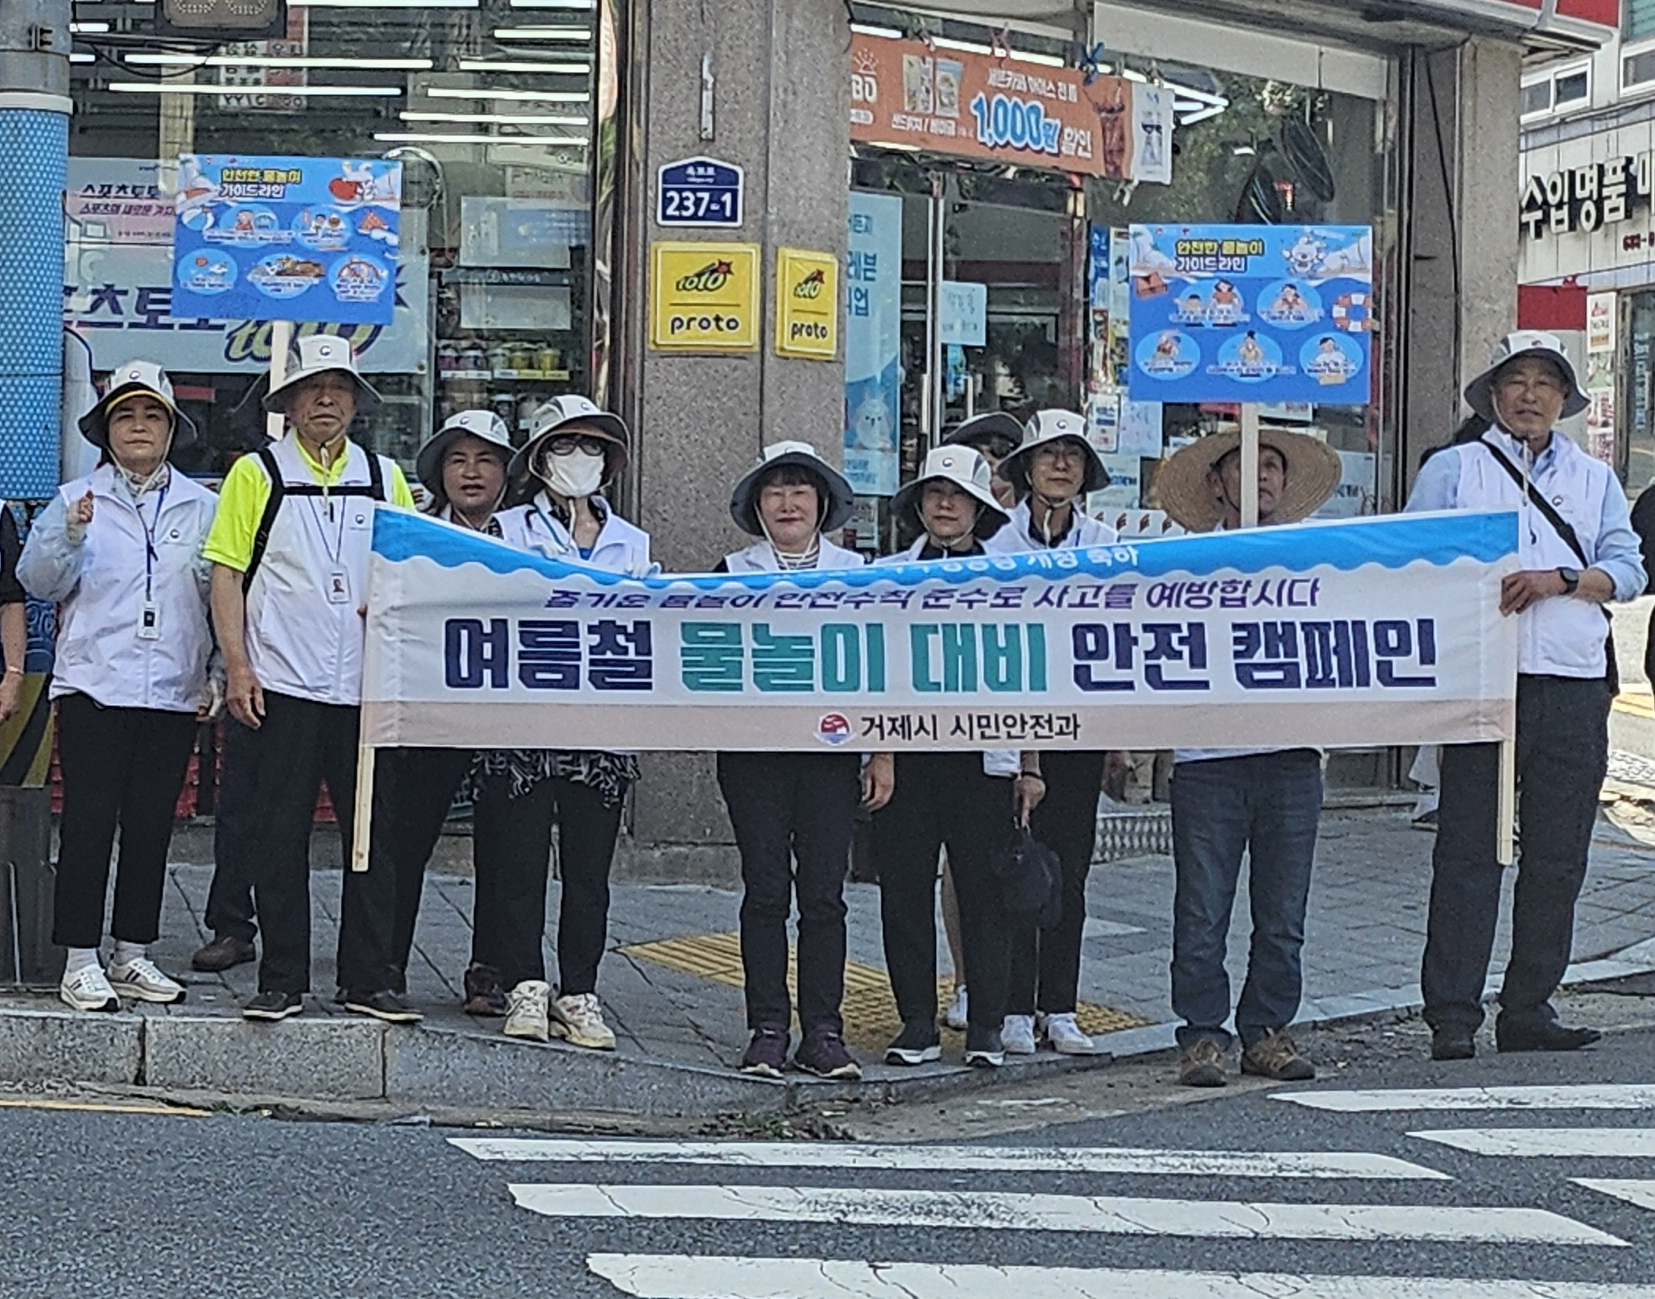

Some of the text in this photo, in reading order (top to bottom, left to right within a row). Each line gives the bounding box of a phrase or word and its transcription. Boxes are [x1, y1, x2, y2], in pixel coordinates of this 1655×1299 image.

[1061, 126, 1092, 158] 할인
[220, 183, 287, 199] 가이드라인
[665, 191, 733, 218] 237-1
[1521, 156, 1627, 240] 수입명품
[1176, 240, 1219, 256] 안전한
[1175, 256, 1248, 273] 가이드라인
[670, 314, 740, 336] proto
[790, 321, 829, 341] proto
[773, 588, 917, 610] 안전수칙
[921, 585, 1027, 610] 준수로
[1033, 582, 1139, 610] 사고를
[1146, 577, 1322, 611] 예방합시다
[444, 618, 1437, 693] 여름철 물놀이 대비 안전 캠페인
[861, 713, 1082, 743] 거제시 시민안전과
